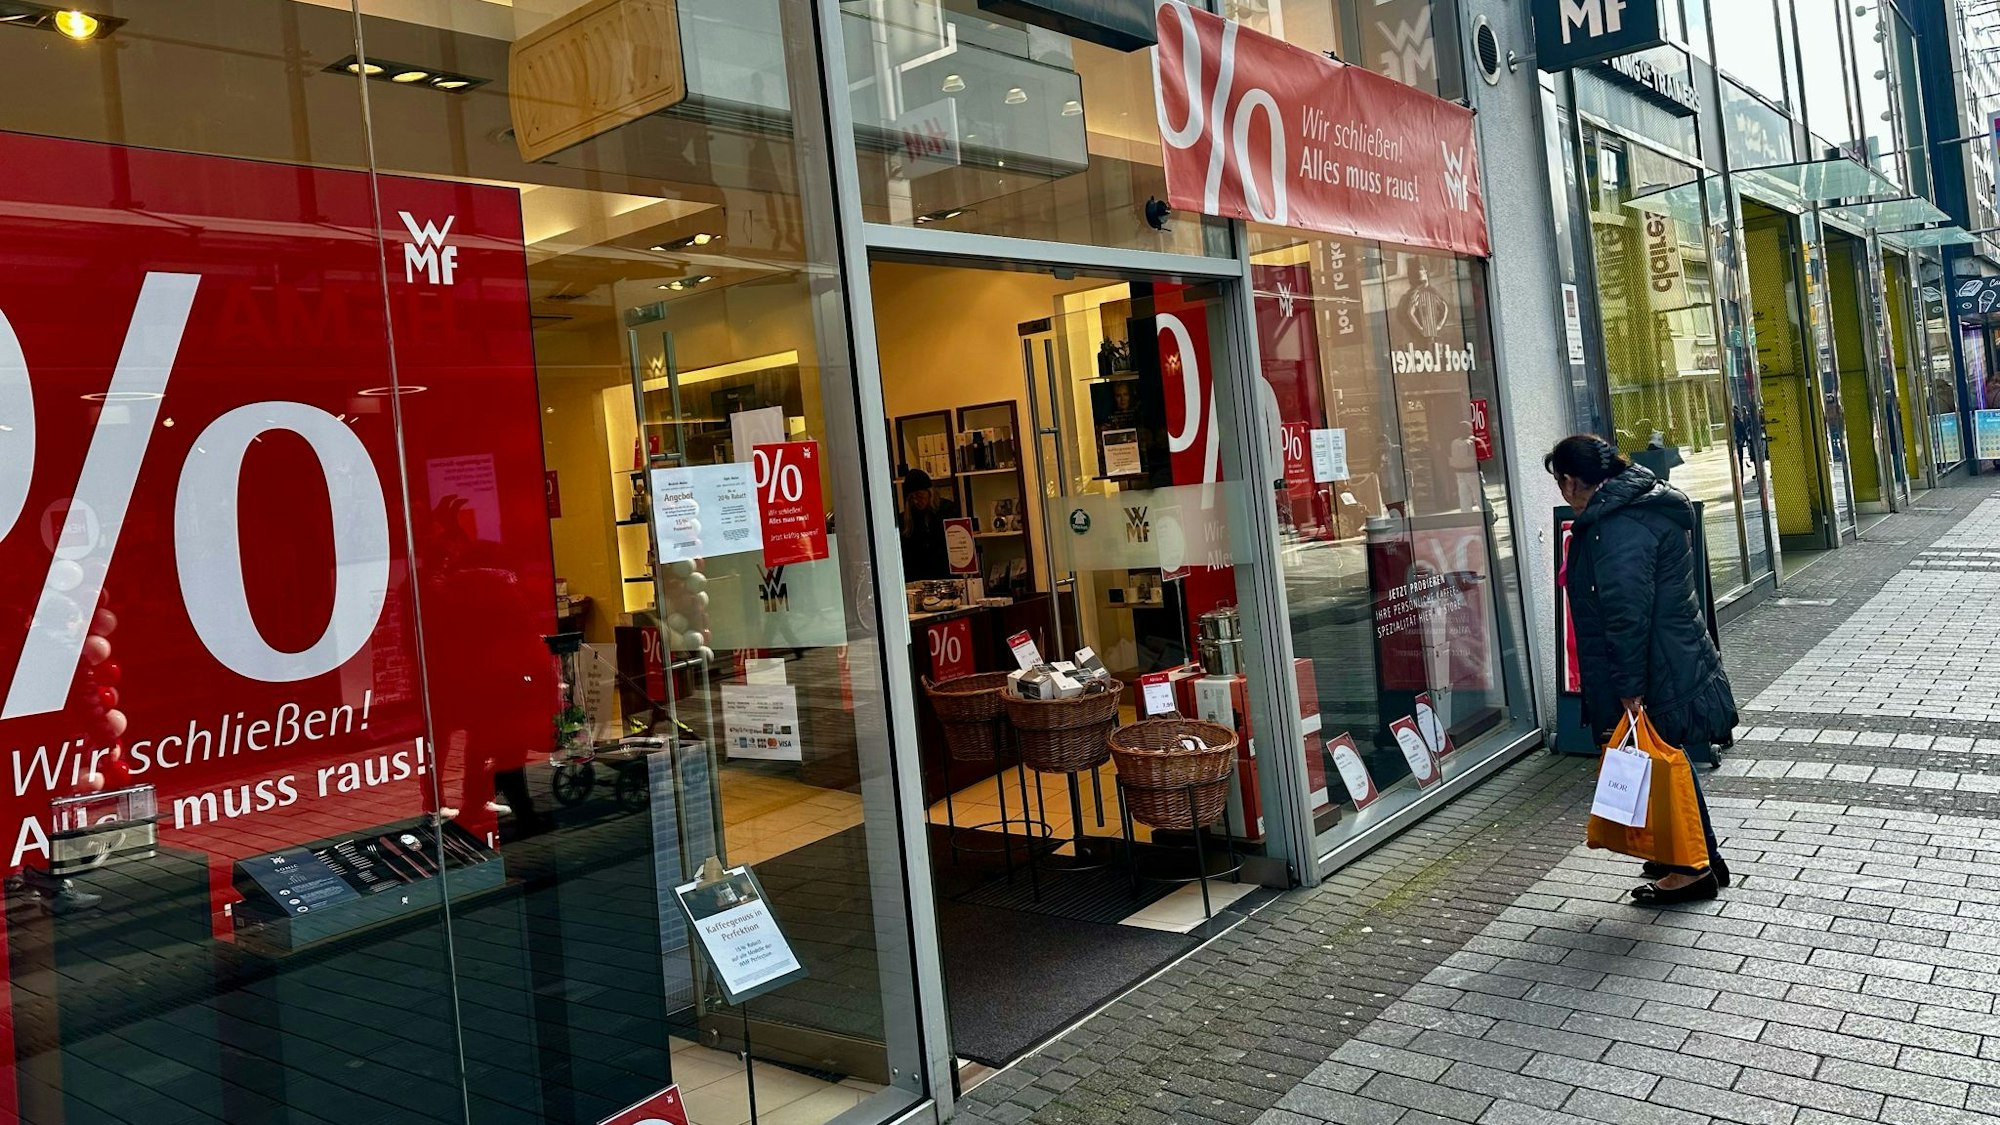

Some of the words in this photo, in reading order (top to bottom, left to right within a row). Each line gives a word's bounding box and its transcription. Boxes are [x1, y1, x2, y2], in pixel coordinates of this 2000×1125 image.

[1155, 0, 1288, 226] %
[1302, 105, 1331, 142] Wir
[1333, 123, 1403, 164] schließen!
[1300, 147, 1341, 187] Alles
[1345, 164, 1382, 195] muss
[1385, 175, 1420, 202] raus!
[1441, 140, 1468, 213] WMF
[398, 210, 458, 285] WMF
[0, 270, 392, 721] %
[664, 491, 694, 503] Angebot
[753, 448, 803, 504] %
[1124, 507, 1150, 543] WMF
[1388, 584, 1408, 602] JETZT
[1409, 574, 1446, 594] PROBIEREN
[1377, 612, 1417, 639] SPEZIALITÄT
[12, 737, 109, 796] Wir
[128, 689, 373, 775] schließen!
[174, 774, 299, 830] muss
[316, 736, 427, 798] raus!
[1608, 781, 1628, 792] DIOR
[705, 912, 754, 934] Kaffeegenuss
[755, 909, 762, 917] in
[721, 923, 760, 941] Perfektion
